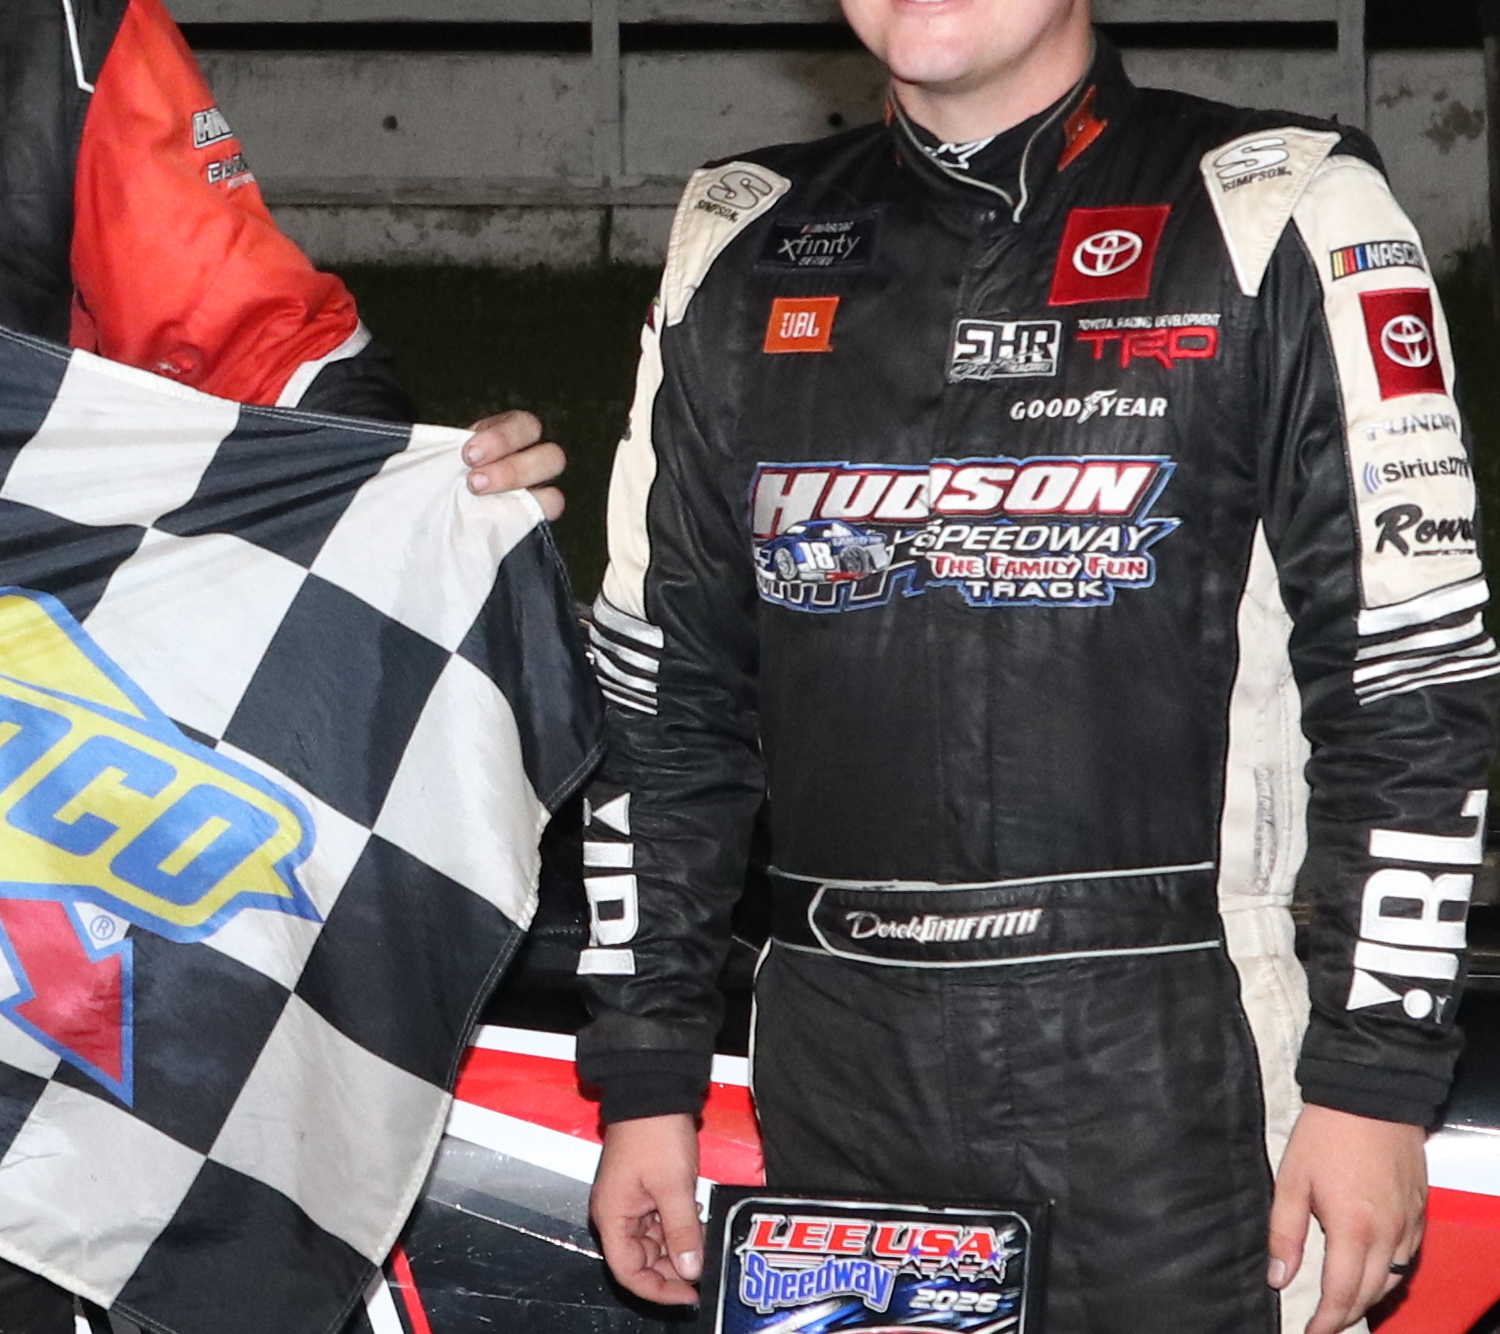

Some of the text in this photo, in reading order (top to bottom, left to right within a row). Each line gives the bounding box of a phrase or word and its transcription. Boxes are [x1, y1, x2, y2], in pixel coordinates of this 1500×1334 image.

[777, 230, 861, 261] xfinity
[779, 310, 821, 340] JBL
[1075, 326, 1220, 369] TRD
[752, 463, 1162, 538] HUDSON
[798, 540, 838, 571] 18
[898, 524, 1159, 556] SPEEDWAY
[963, 578, 1107, 599] TRACK
[919, 907, 1044, 943] GRIFFITH
[750, 1214, 1001, 1265] LEE USA
[743, 1252, 895, 1310] Speedway
